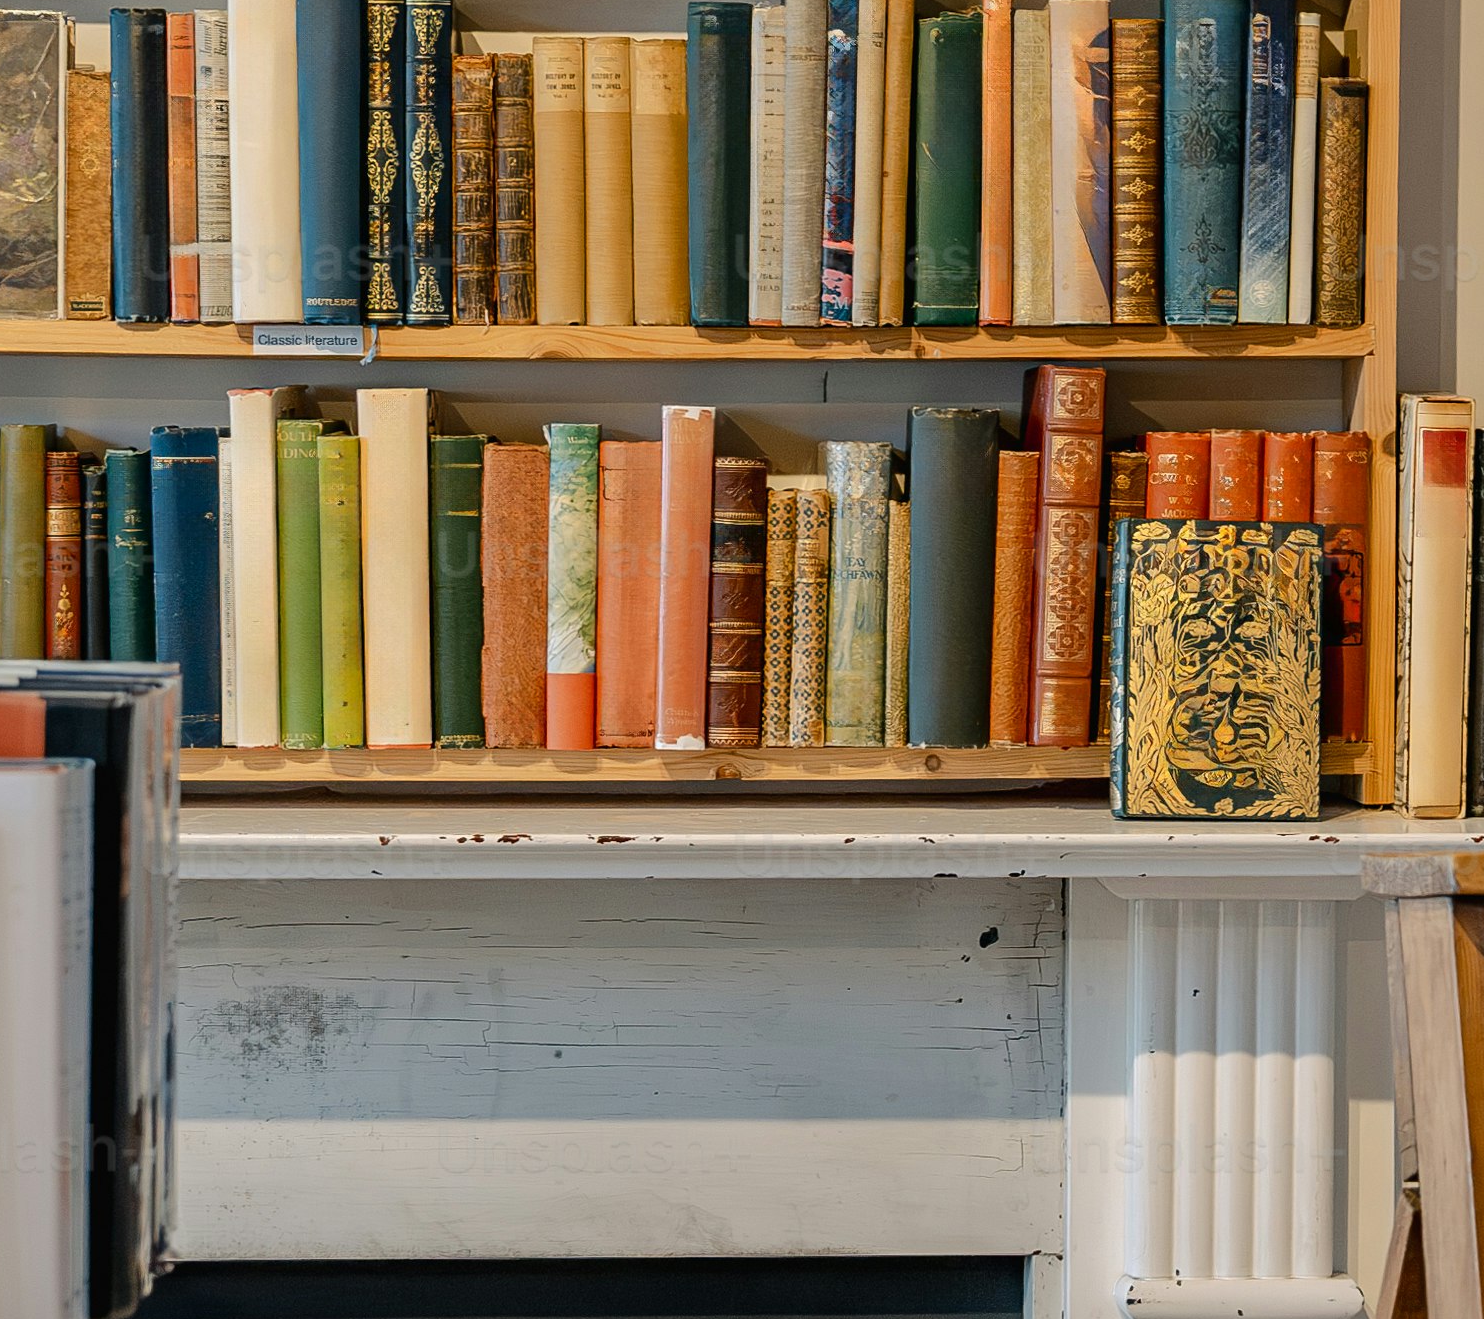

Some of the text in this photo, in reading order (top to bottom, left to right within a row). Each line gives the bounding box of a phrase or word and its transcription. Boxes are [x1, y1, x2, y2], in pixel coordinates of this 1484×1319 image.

[306, 297, 357, 306] ROUTLEDGE
[258, 334, 358, 347] Classic literature
